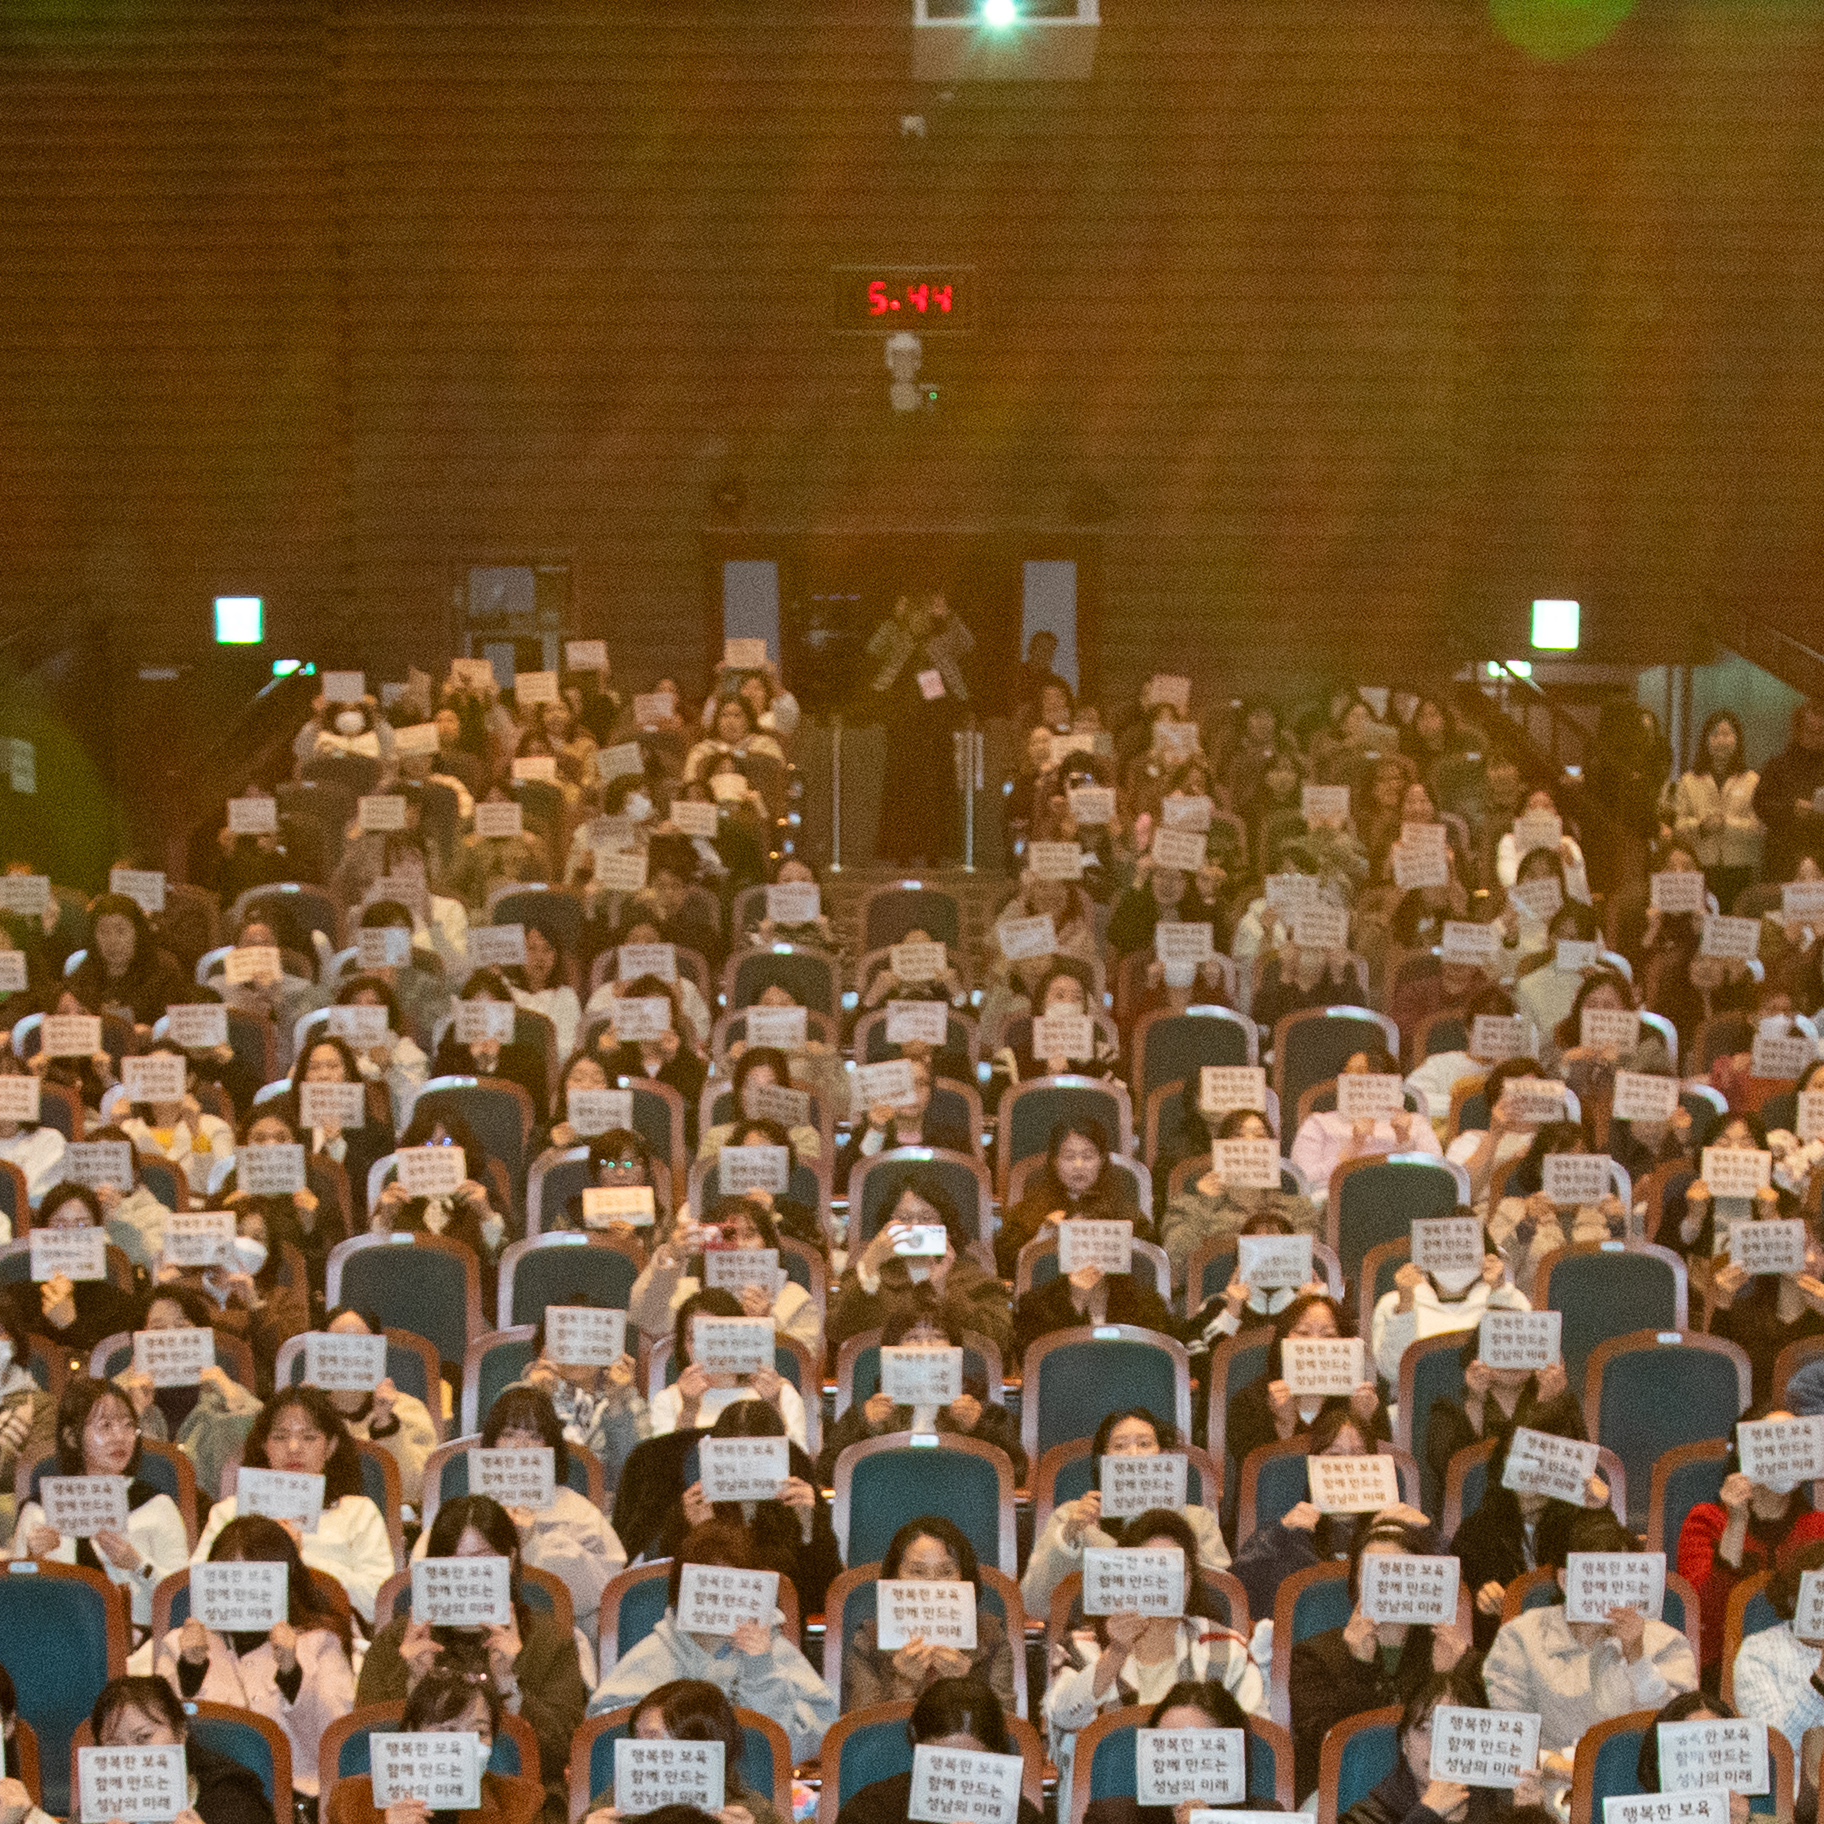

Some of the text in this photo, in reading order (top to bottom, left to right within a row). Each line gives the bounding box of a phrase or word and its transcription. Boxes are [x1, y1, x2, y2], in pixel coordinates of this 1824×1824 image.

[1151, 1737, 1226, 1752] 행복한 보육
[94, 1754, 168, 1770] 행복한 보육
[1152, 1758, 1227, 1774] 함께 만드는
[95, 1776, 169, 1792] 함께 만드는
[1152, 1779, 1228, 1795] 성남의 미래
[96, 1796, 171, 1813] 성남의 미래
[1622, 1800, 1710, 1823] 행복한 보육
